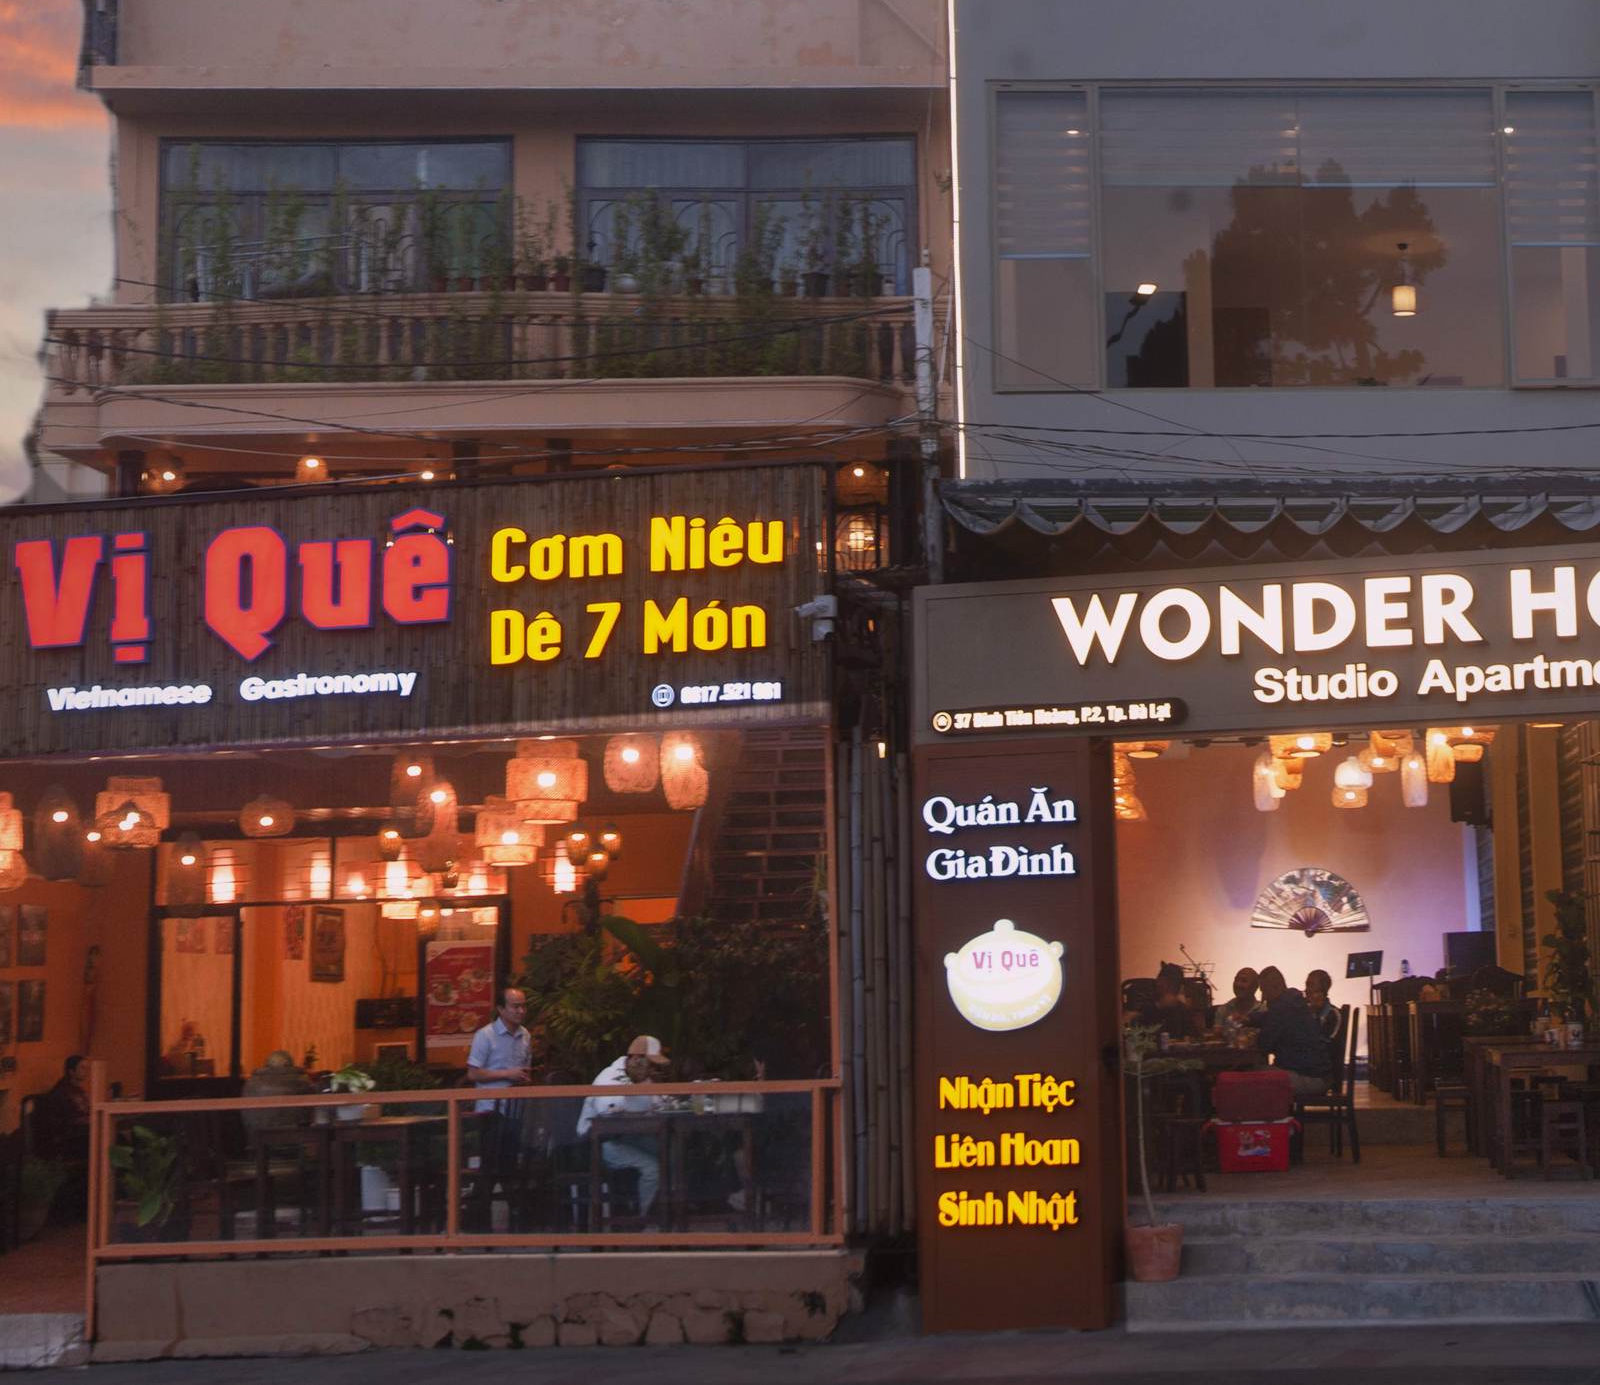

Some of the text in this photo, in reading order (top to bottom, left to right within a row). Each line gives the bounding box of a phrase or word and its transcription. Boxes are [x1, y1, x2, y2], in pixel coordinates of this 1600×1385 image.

[491, 515, 784, 583] Cơm Niêu
[15, 509, 449, 661] Vị Quê
[490, 597, 766, 665] Dê 7 Món
[1051, 566, 1600, 666] WONDER H
[47, 672, 417, 711] Vietnamese Gastronomy
[1253, 663, 1398, 703] Studio
[953, 713, 972, 729] 37
[922, 787, 1077, 834] Quán Ăn
[926, 844, 1076, 880] Gia Đình
[972, 948, 1039, 973] Vị Quê
[939, 1073, 1075, 1115] Nhận Tiệc
[935, 1132, 1080, 1168] Liên Hoan
[938, 1190, 1078, 1231] Sinh Nhật
